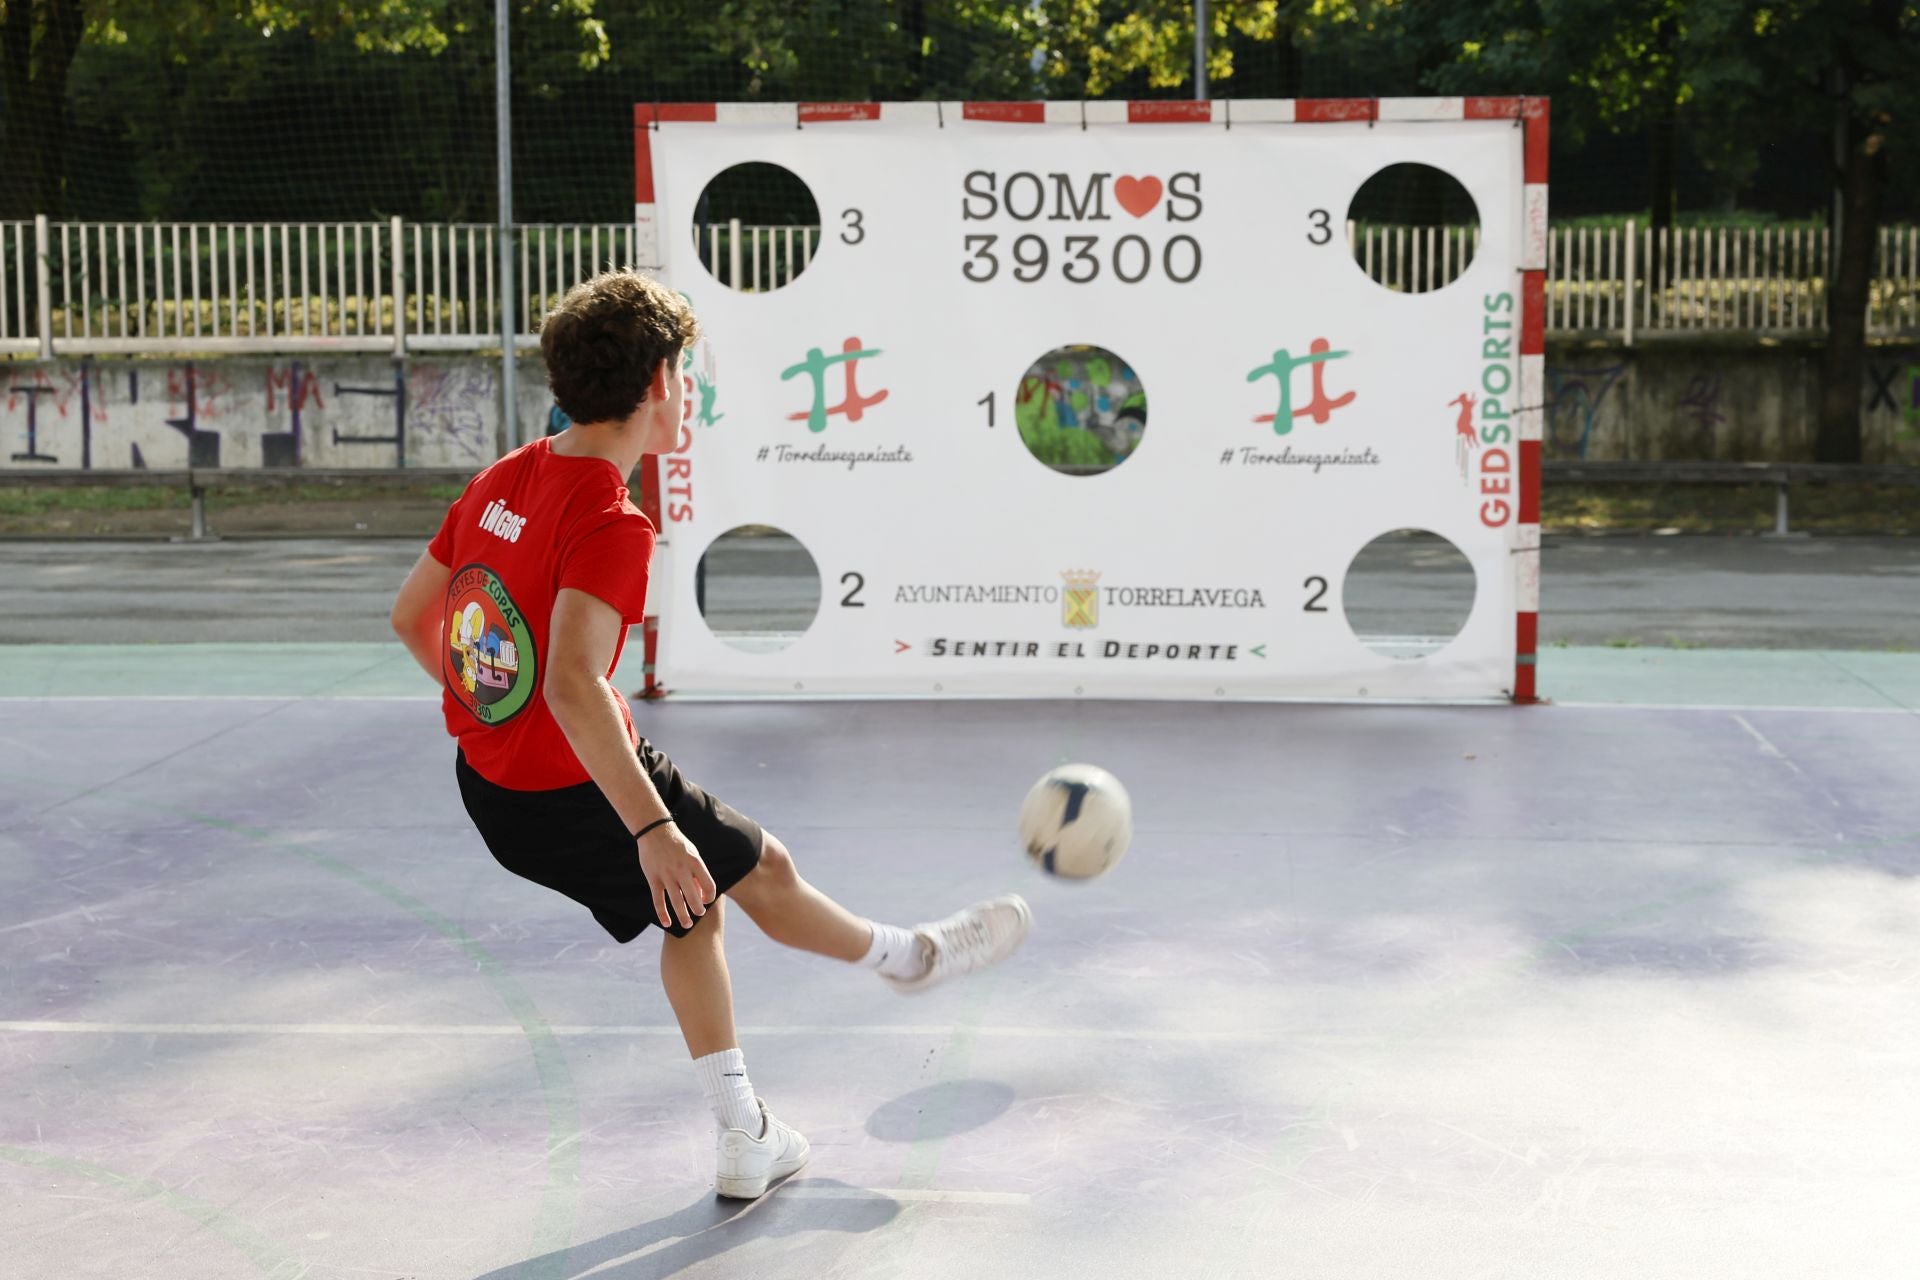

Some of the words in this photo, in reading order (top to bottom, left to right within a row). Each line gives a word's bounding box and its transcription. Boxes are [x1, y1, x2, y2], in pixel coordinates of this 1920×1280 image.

[841, 208, 865, 245] 3
[1307, 208, 1332, 245] 3
[962, 233, 1202, 284] 39300
[977, 391, 995, 428] 1
[1479, 291, 1514, 528] GEDSPORTS
[451, 570, 475, 600] REYES
[489, 579, 520, 628] COPAS
[840, 571, 865, 608] 2
[895, 585, 1059, 603] AYUNTAMIENTO
[1104, 587, 1266, 608] TORRELAVEGA
[1303, 575, 1328, 612] 2
